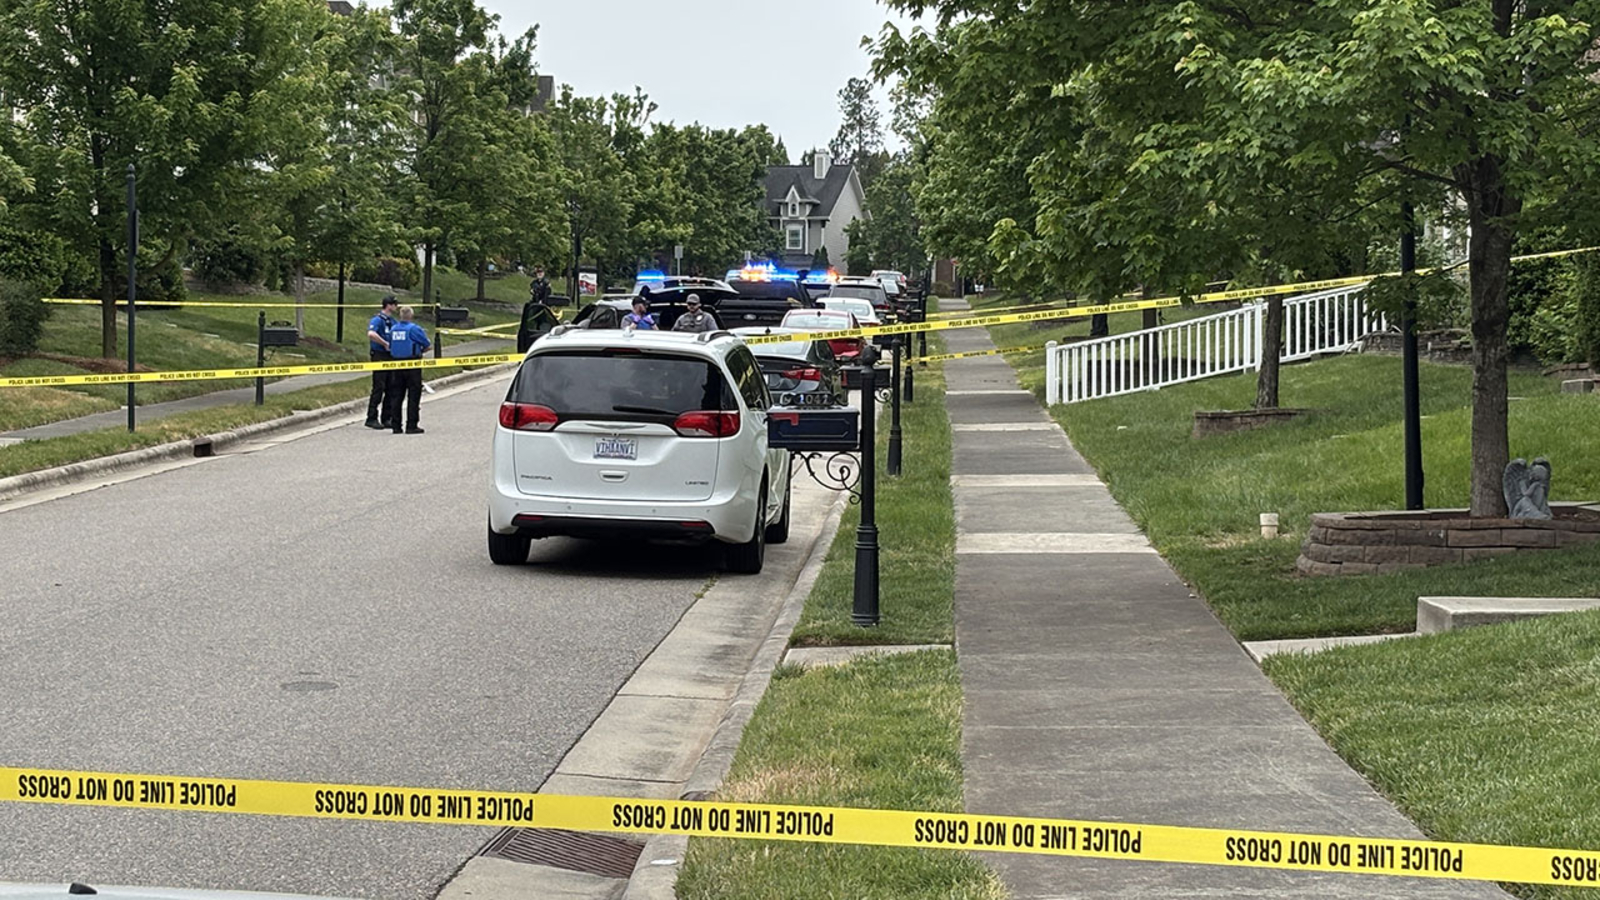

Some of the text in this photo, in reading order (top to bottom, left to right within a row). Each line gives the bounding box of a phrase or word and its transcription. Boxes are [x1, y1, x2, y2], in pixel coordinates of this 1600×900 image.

[19, 775, 236, 806] POLICE LINE DO NOT CROSS
[315, 790, 533, 821] POLICE LINE DO NOT CROSS
[613, 804, 833, 836] POLICE LINE DO NOT CROSS
[915, 819, 1141, 853] POLICE LINE DO NOT CROSS
[1226, 837, 1462, 872] POLICE LINE DO NOT CROSS
[1552, 856, 1600, 881] ROSS
